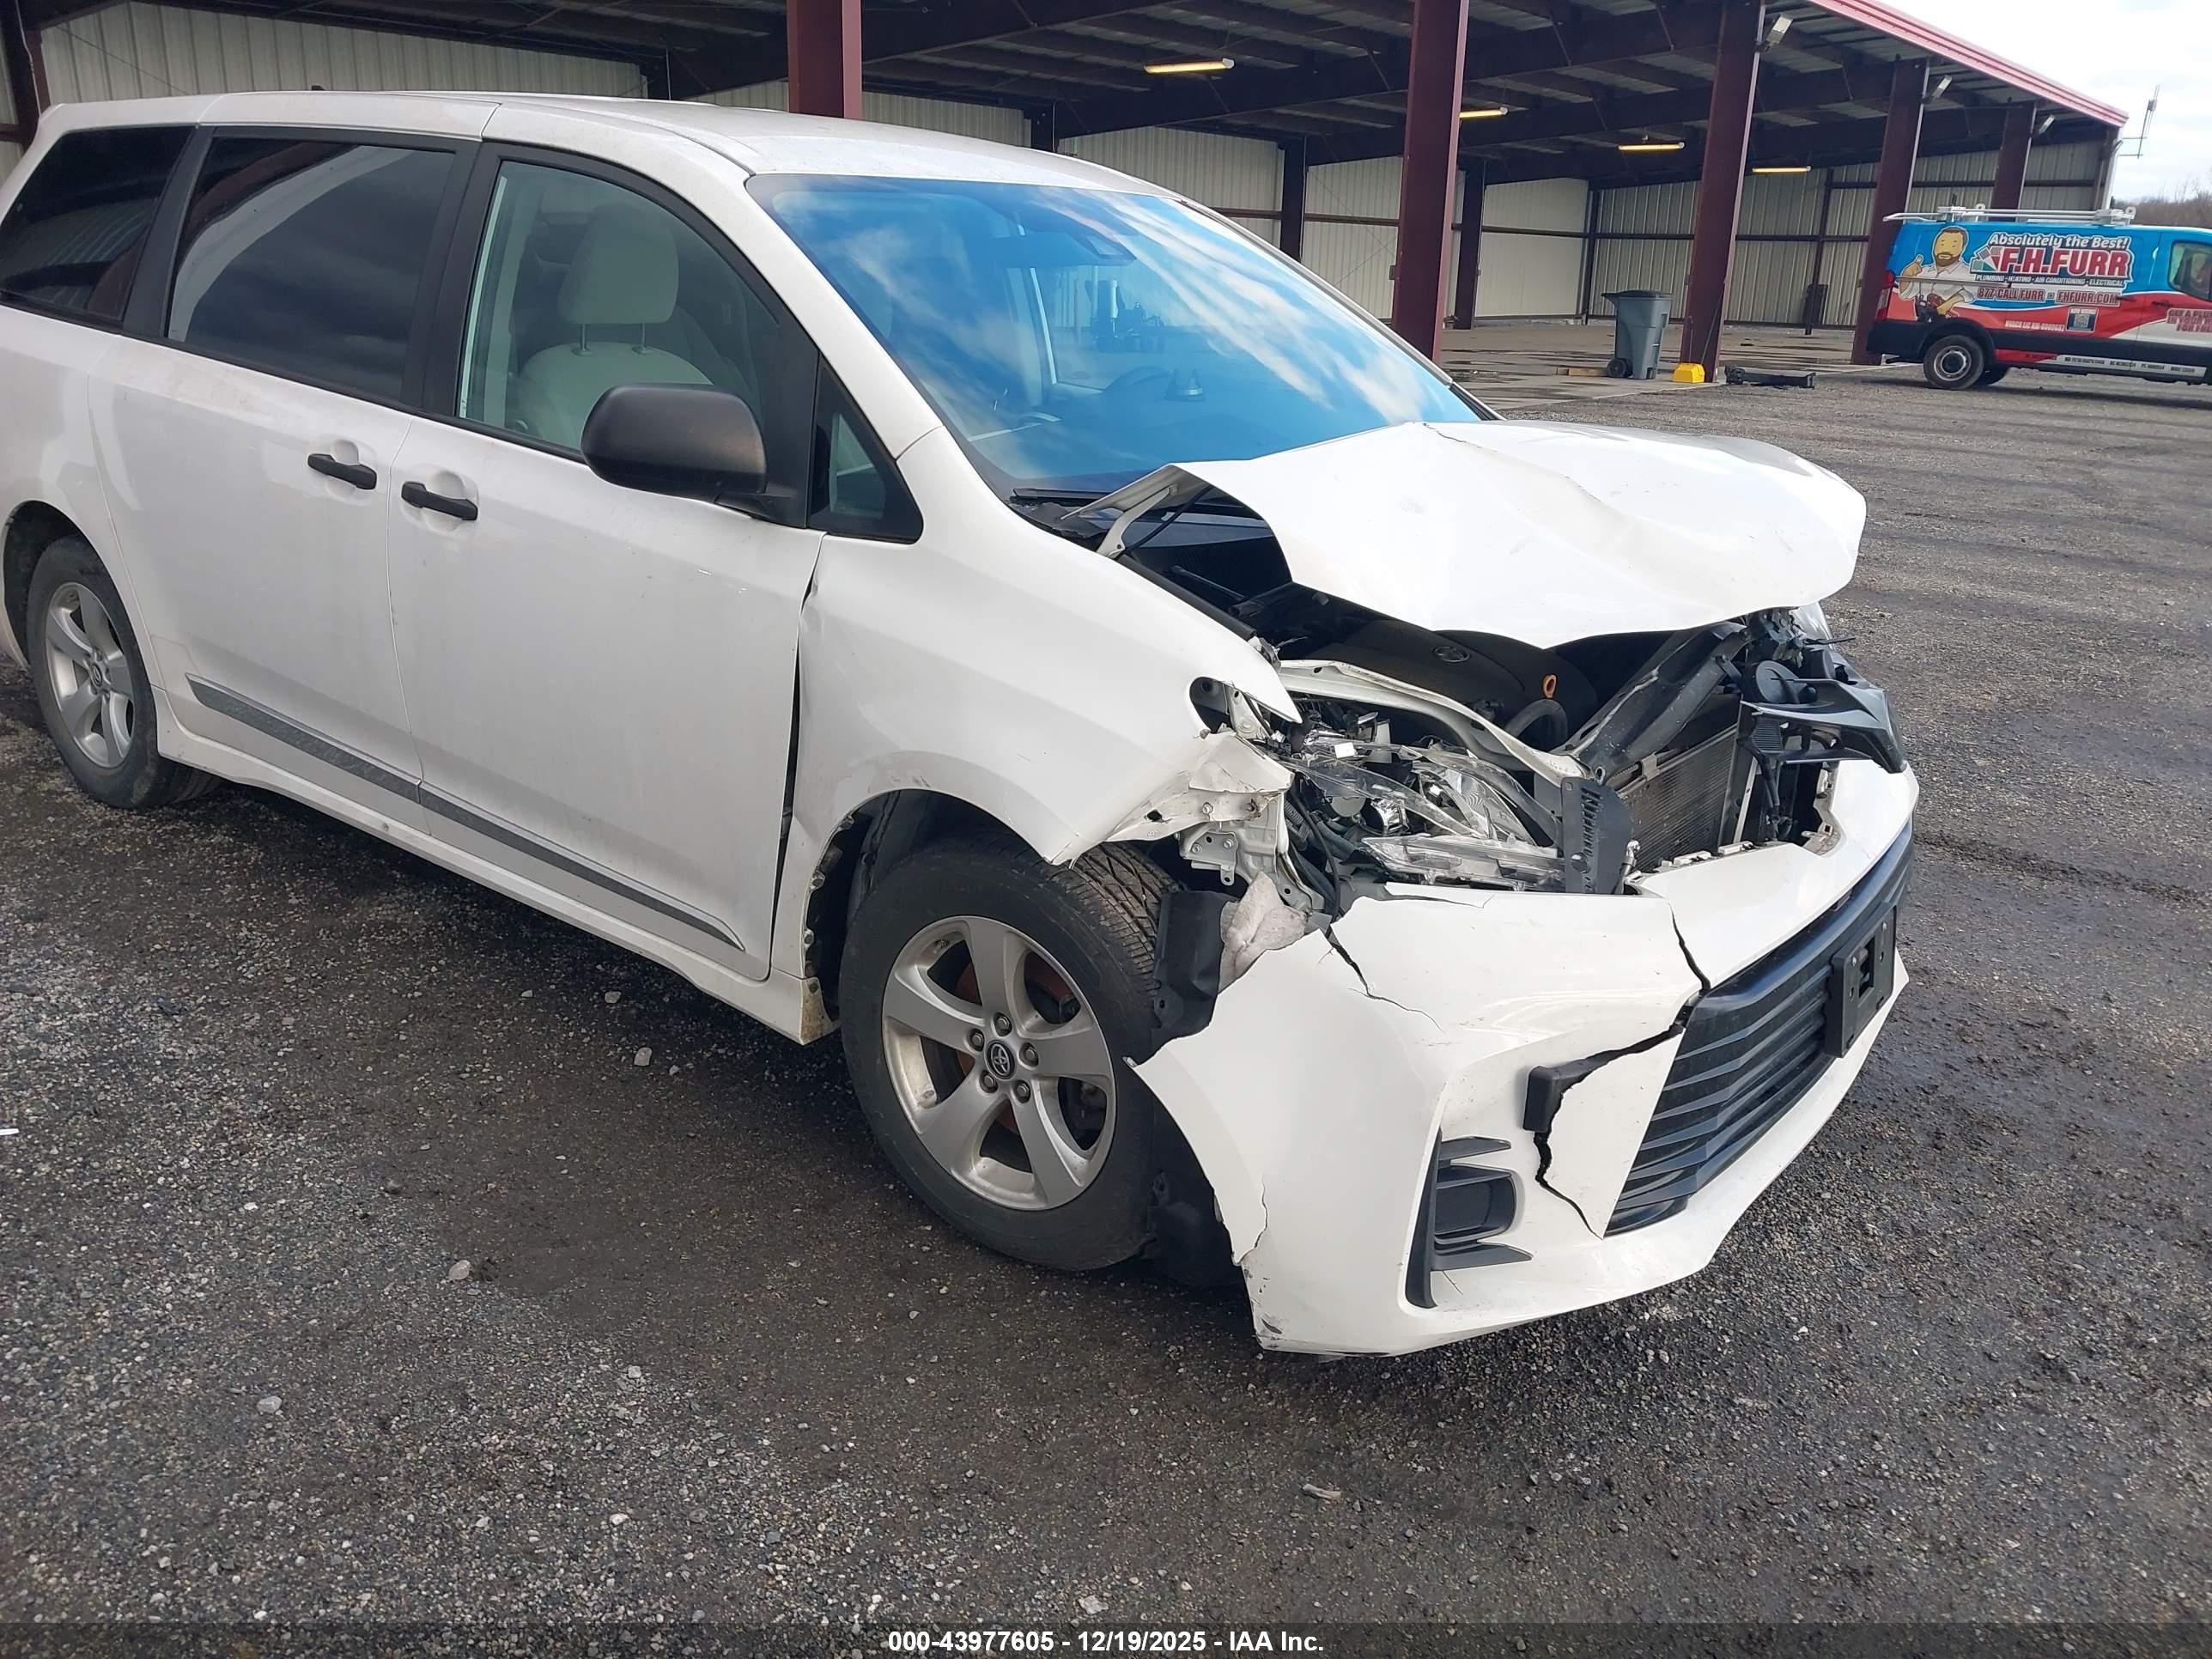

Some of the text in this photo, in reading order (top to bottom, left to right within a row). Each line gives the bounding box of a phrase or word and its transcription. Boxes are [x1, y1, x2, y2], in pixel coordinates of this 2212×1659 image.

[1989, 233, 2129, 250] Absolutely the Best!
[2057, 290, 2118, 304] FHFURR.COM
